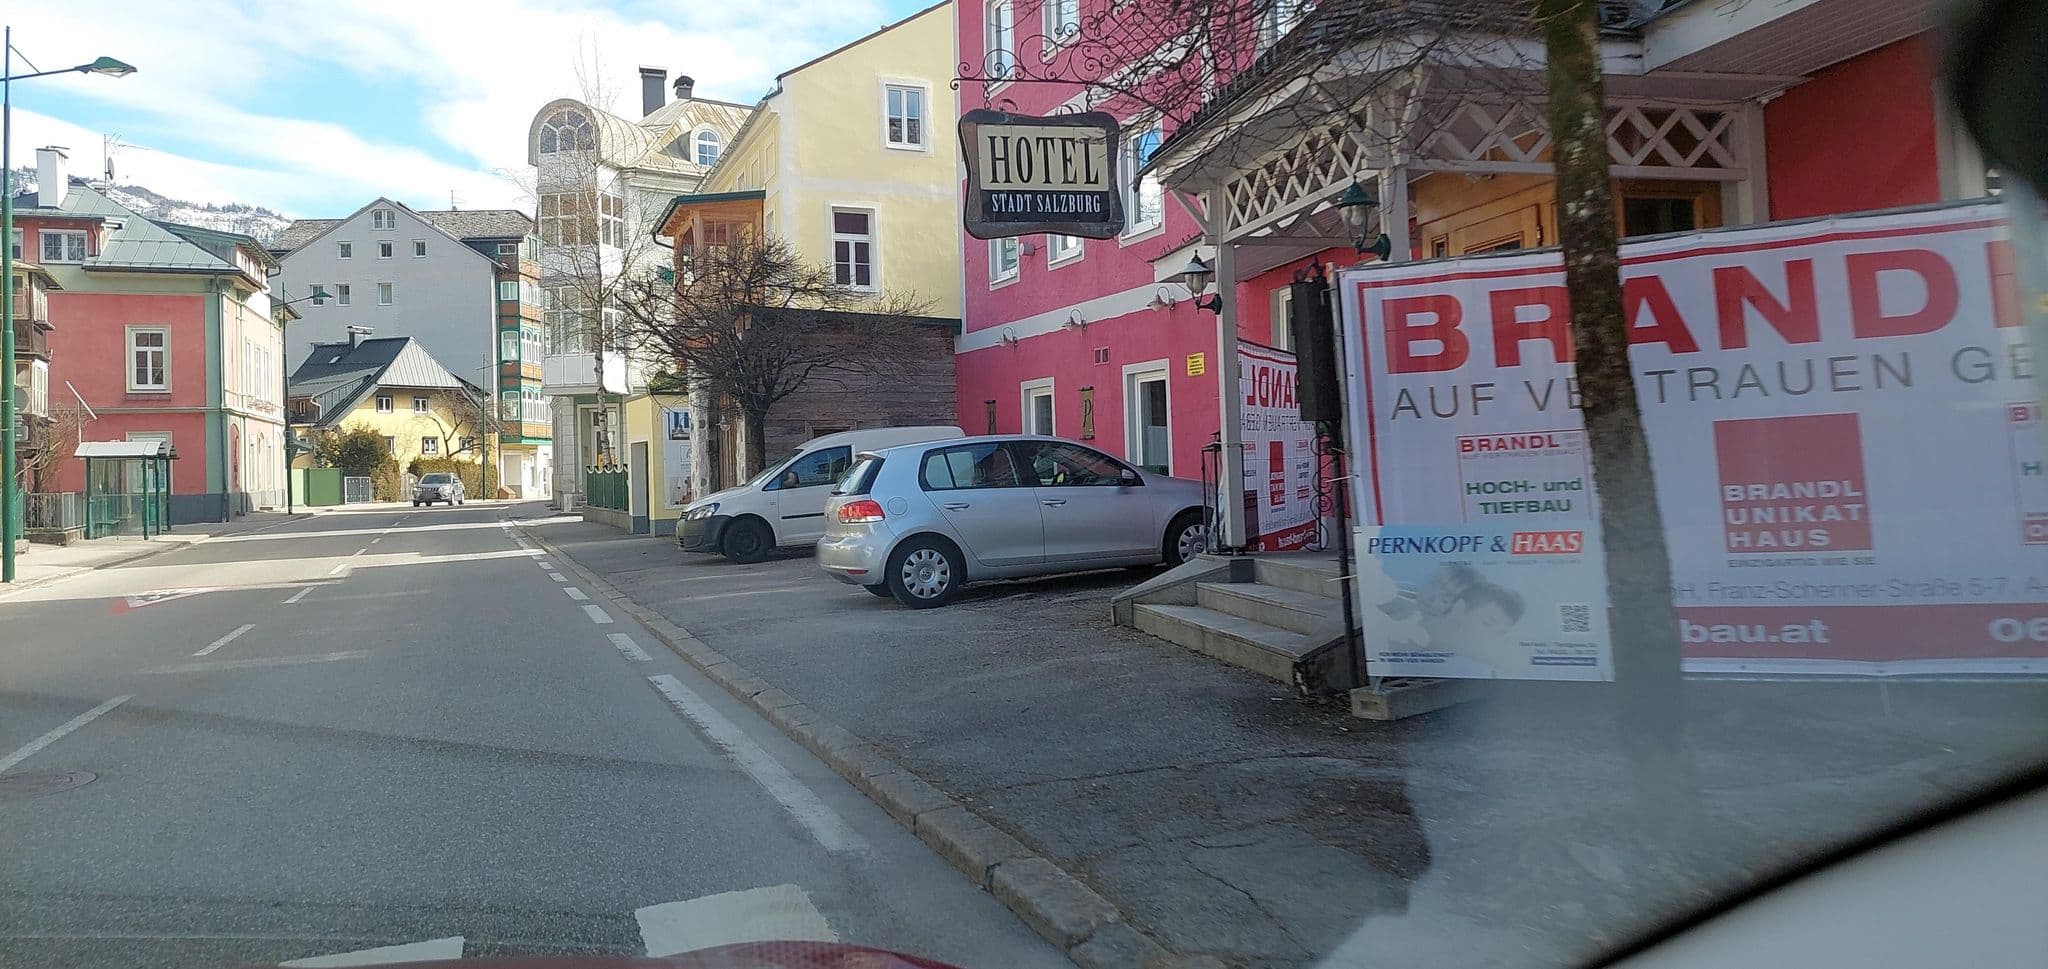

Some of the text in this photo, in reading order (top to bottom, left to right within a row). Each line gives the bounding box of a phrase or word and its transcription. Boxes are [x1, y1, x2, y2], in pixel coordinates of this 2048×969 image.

[988, 136, 1099, 185] HOTEL
[991, 194, 1100, 213] STADT SALZBURG
[1391, 382, 1495, 420] AUF
[1524, 351, 1912, 412] VETRAUEN
[1461, 434, 1560, 452] BRANDL
[1466, 477, 1582, 495] HOCH- und
[1723, 480, 1863, 502] BRANDL
[1480, 499, 1570, 514] TIEFBAU
[1727, 504, 1863, 525] UNIKAT
[1369, 532, 1581, 554] PERNKOPF & HAAS
[1728, 529, 1831, 548] HAUS
